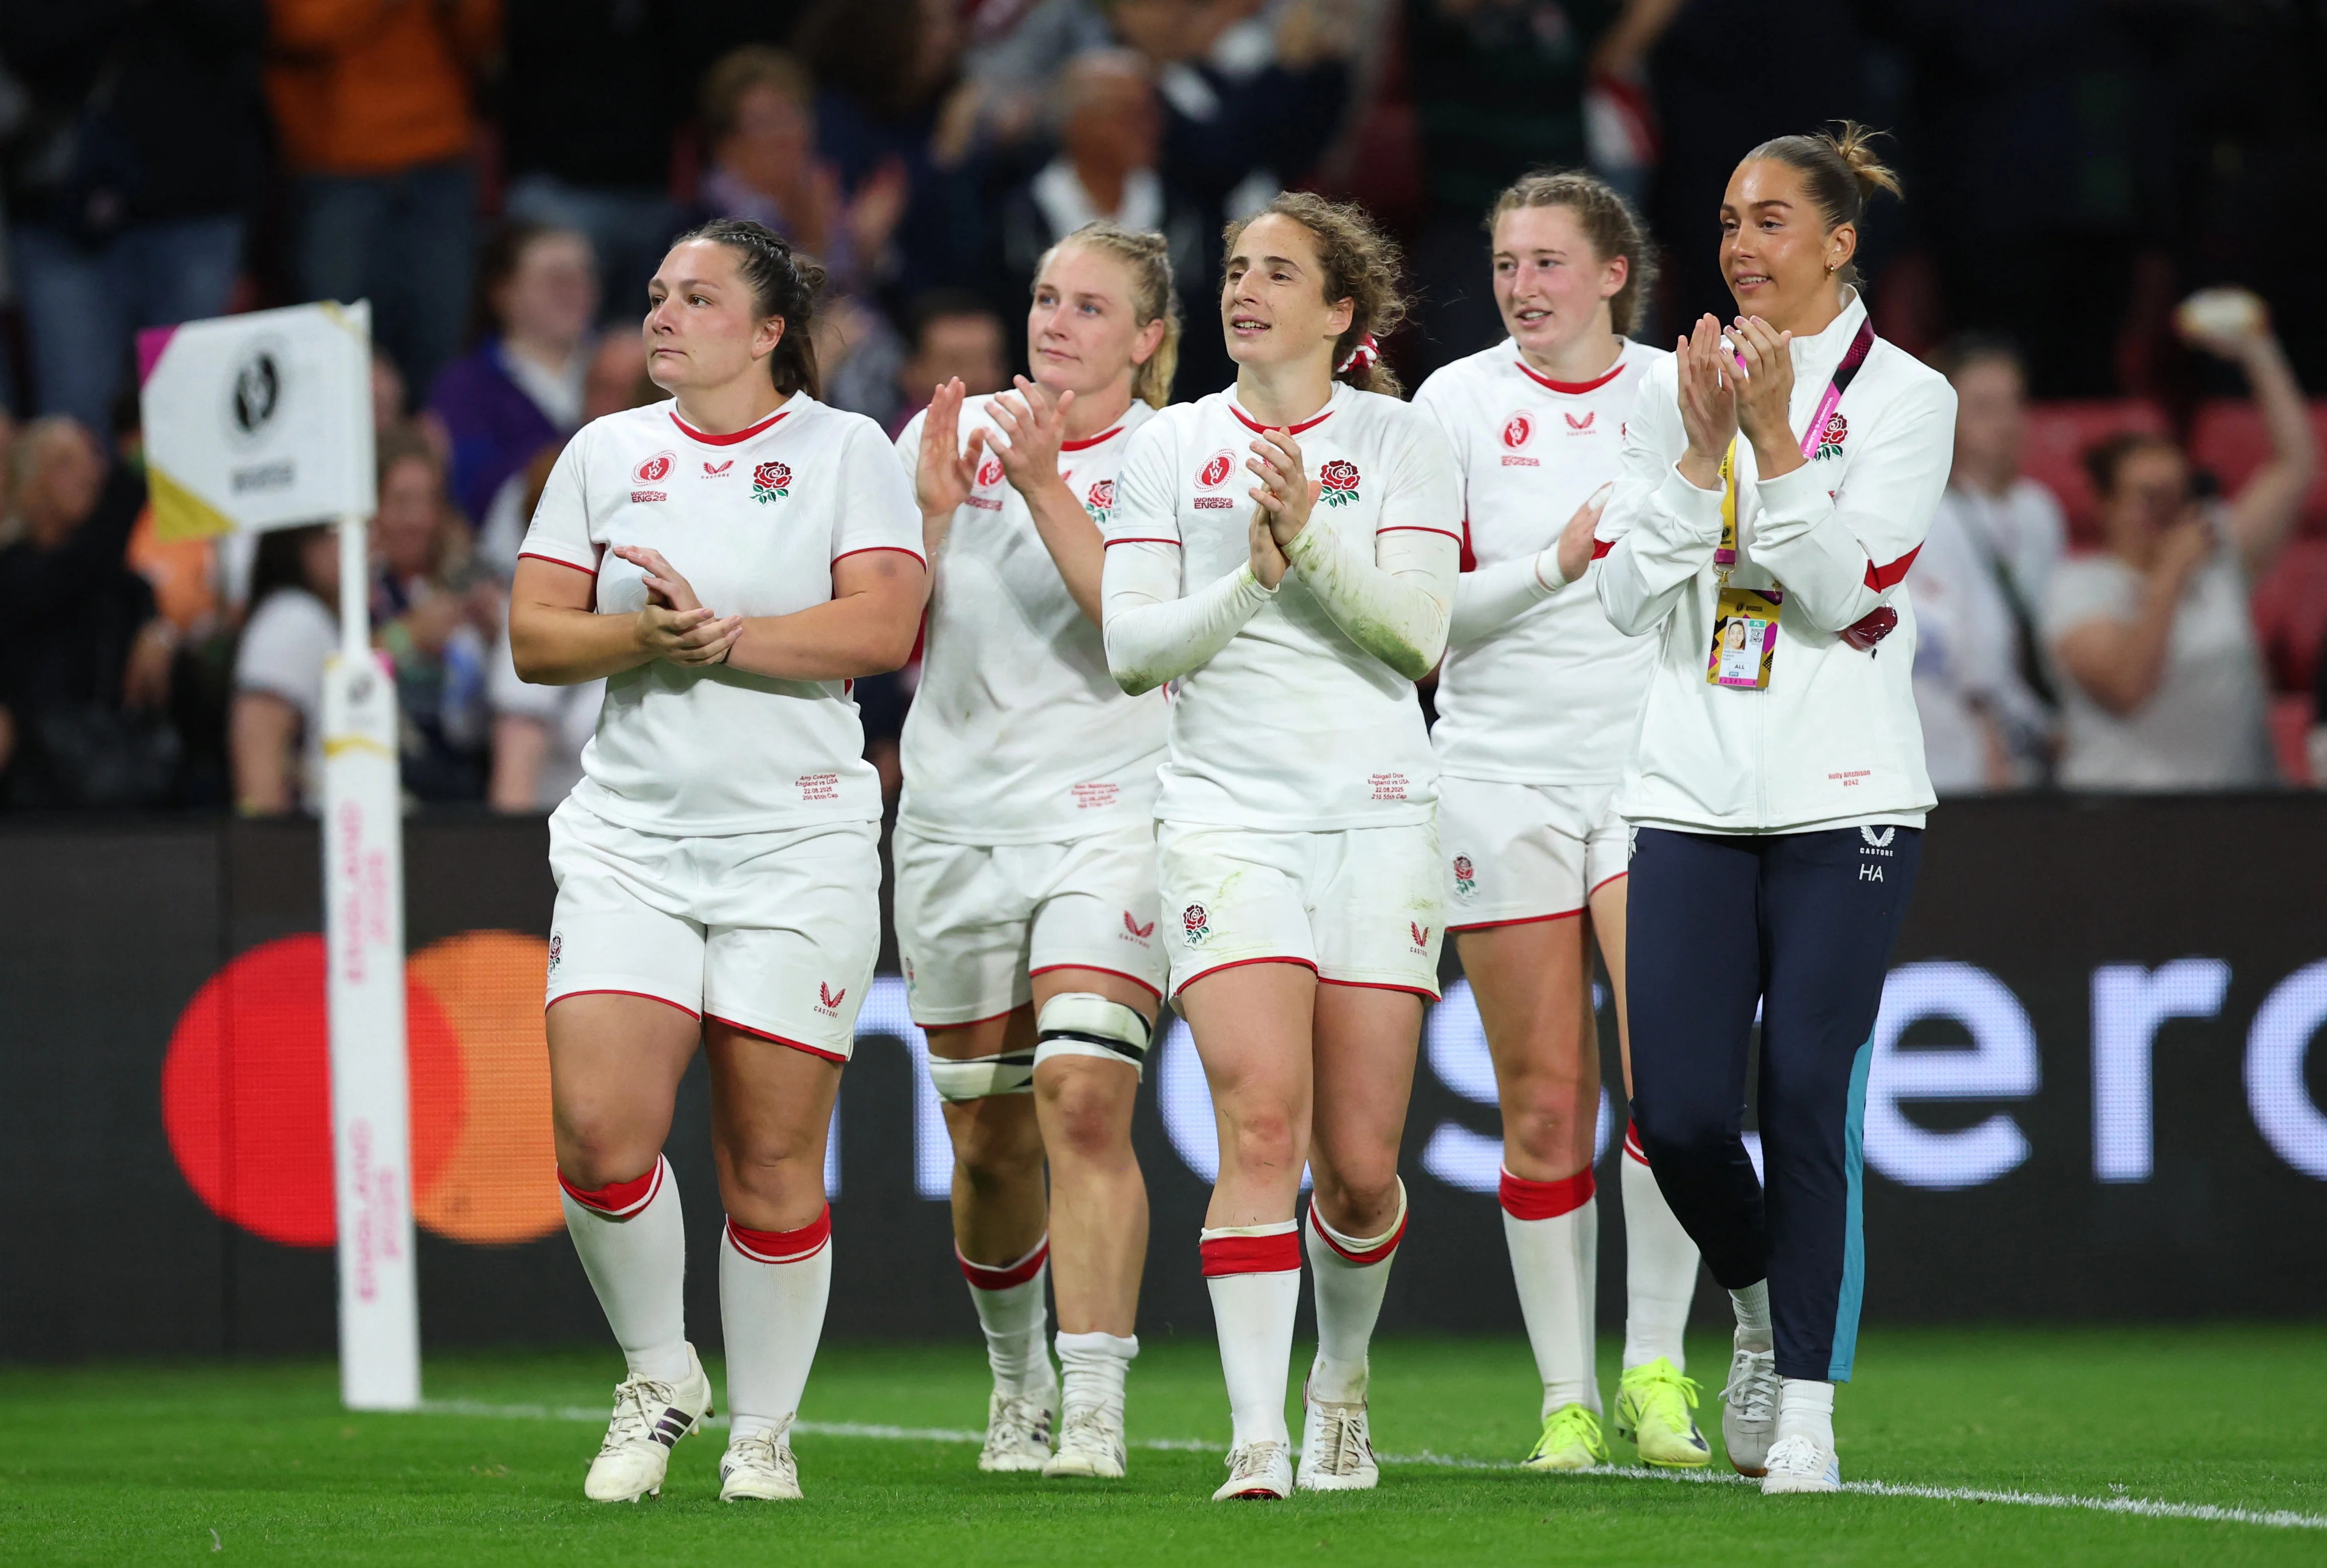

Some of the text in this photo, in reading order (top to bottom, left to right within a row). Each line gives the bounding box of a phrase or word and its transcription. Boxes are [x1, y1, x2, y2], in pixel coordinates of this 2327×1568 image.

[1209, 459, 1223, 485] RWC
[632, 495, 666, 503] ENG25
[1843, 770, 1871, 778] Aitchison
[1860, 847, 1893, 857] CASTORE
[1859, 863, 1883, 882] HA
[813, 1005, 838, 1018] CASTORE
